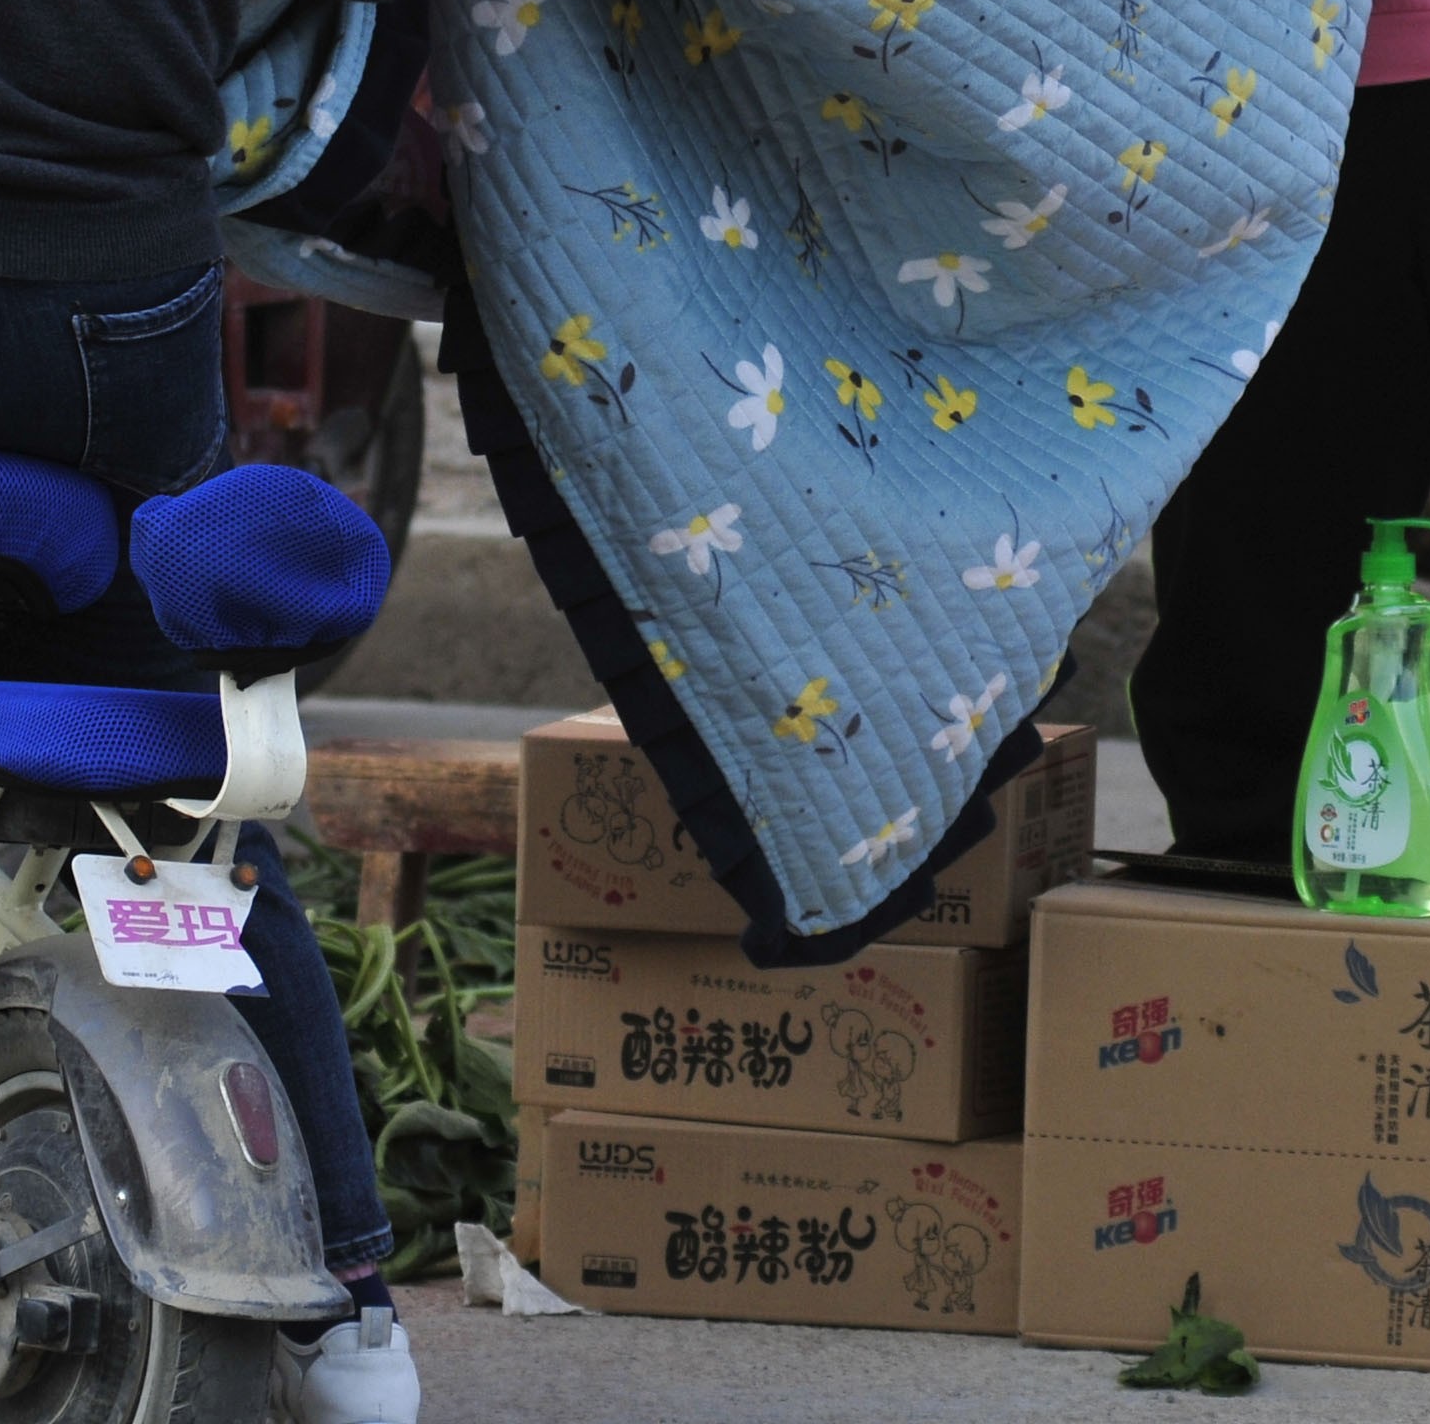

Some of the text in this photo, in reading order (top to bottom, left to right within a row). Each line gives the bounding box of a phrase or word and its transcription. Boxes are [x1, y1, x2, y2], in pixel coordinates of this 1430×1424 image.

[106, 899, 244, 951] 爱玛
[543, 940, 612, 974] WDS
[1112, 996, 1170, 1039] 奇强
[621, 1007, 813, 1089] 酸辣粉
[579, 1141, 655, 1174] WDS
[1108, 1177, 1165, 1219] 奇强
[665, 1205, 877, 1286] 酸辣粉
